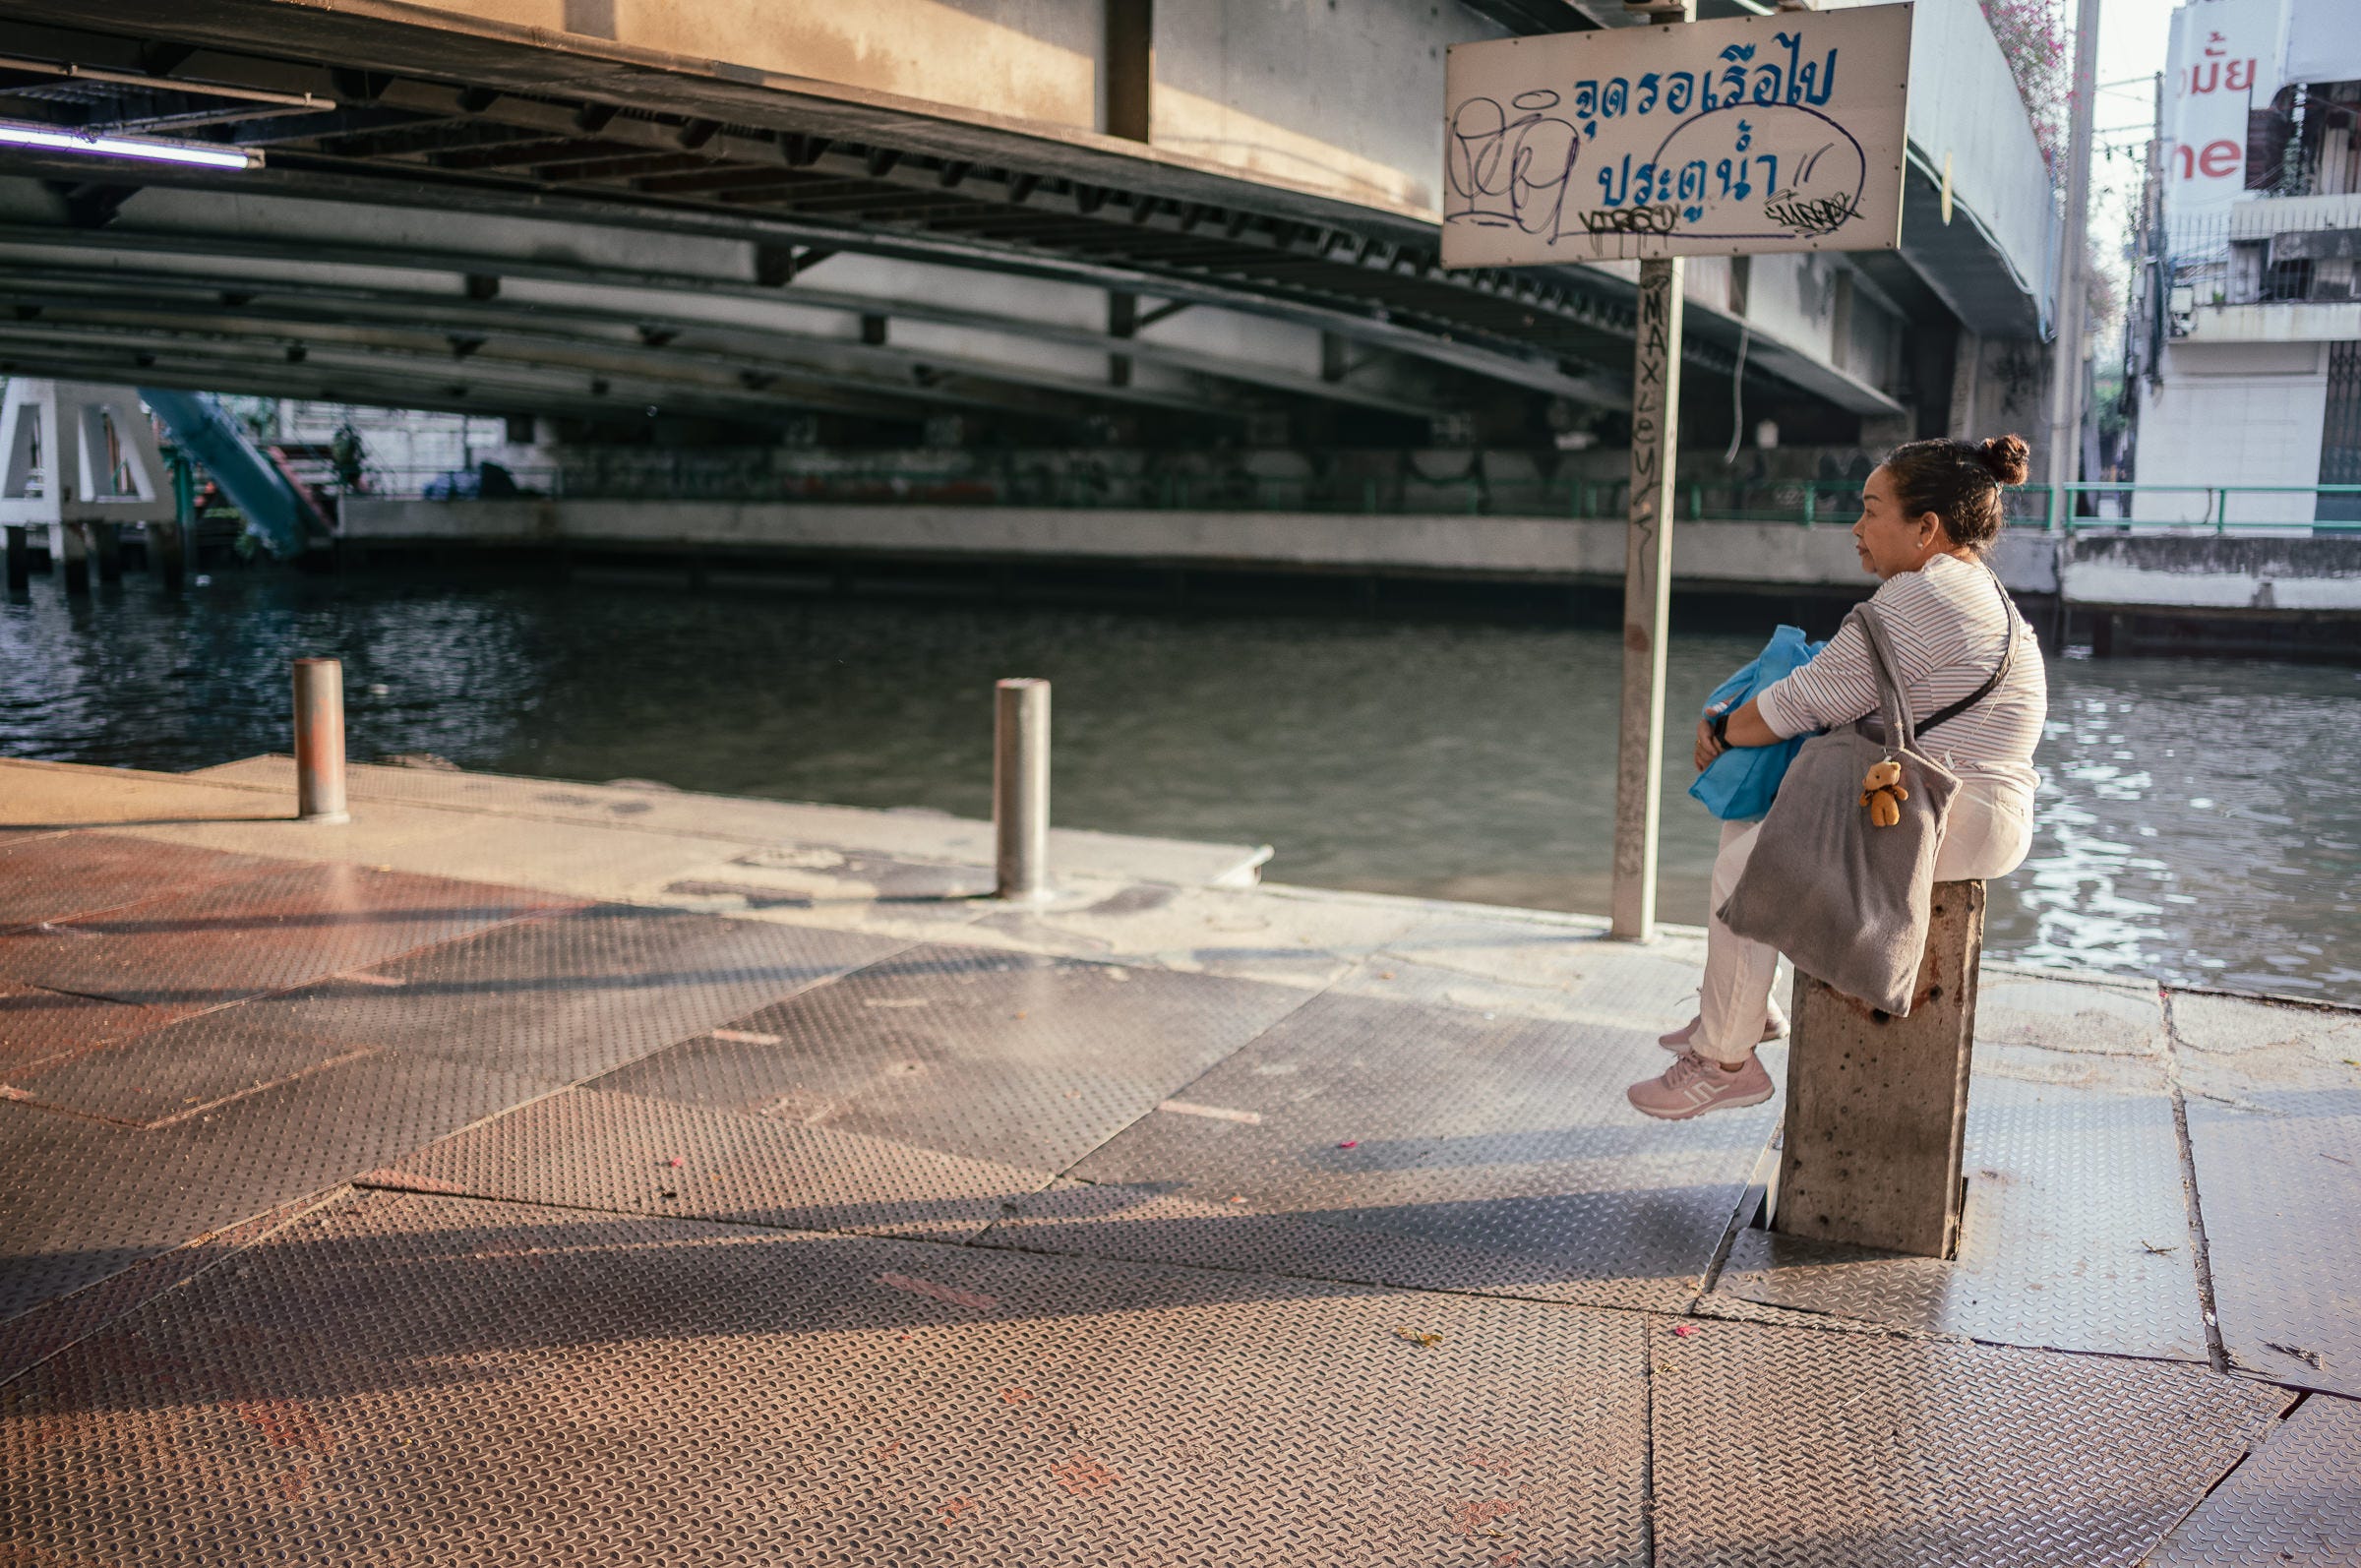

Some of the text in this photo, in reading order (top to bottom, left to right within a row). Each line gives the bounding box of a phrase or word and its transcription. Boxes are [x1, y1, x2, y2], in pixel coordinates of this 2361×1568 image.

[1574, 31, 1839, 141] จุดรอเรือไป
[2178, 31, 2257, 95] มั้ย
[1597, 119, 1778, 224] ประตูน้ำ
